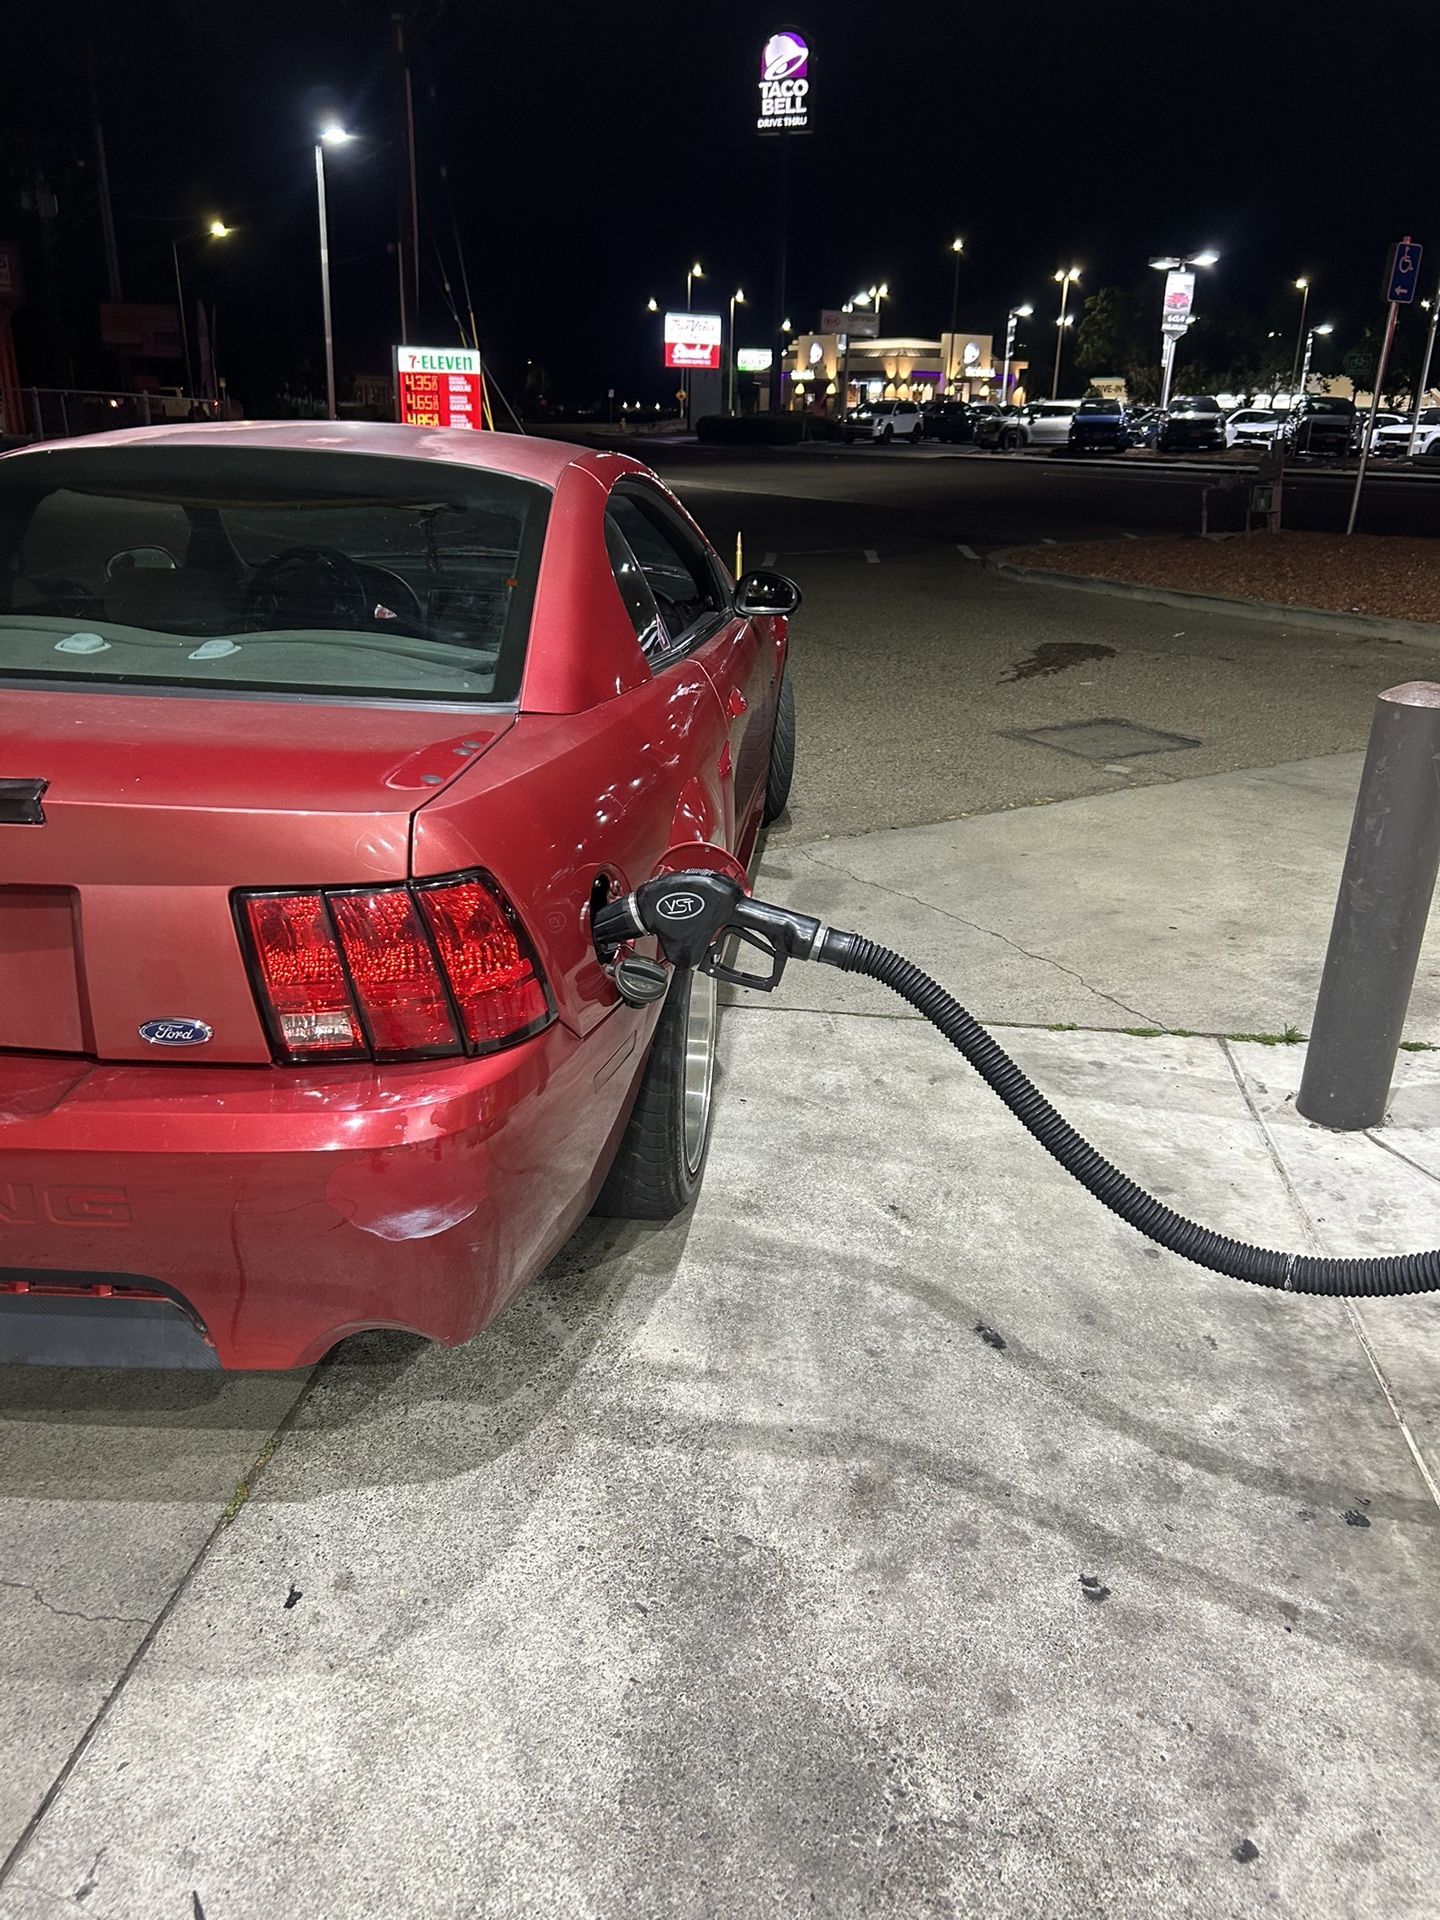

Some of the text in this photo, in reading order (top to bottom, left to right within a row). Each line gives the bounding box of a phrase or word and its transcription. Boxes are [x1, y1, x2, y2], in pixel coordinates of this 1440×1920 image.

[759, 79, 809, 99] TACO
[762, 97, 807, 115] BELL
[757, 116, 808, 128] DRIVE THRU
[664, 898, 695, 915] VST
[155, 1024, 194, 1040] Ford
